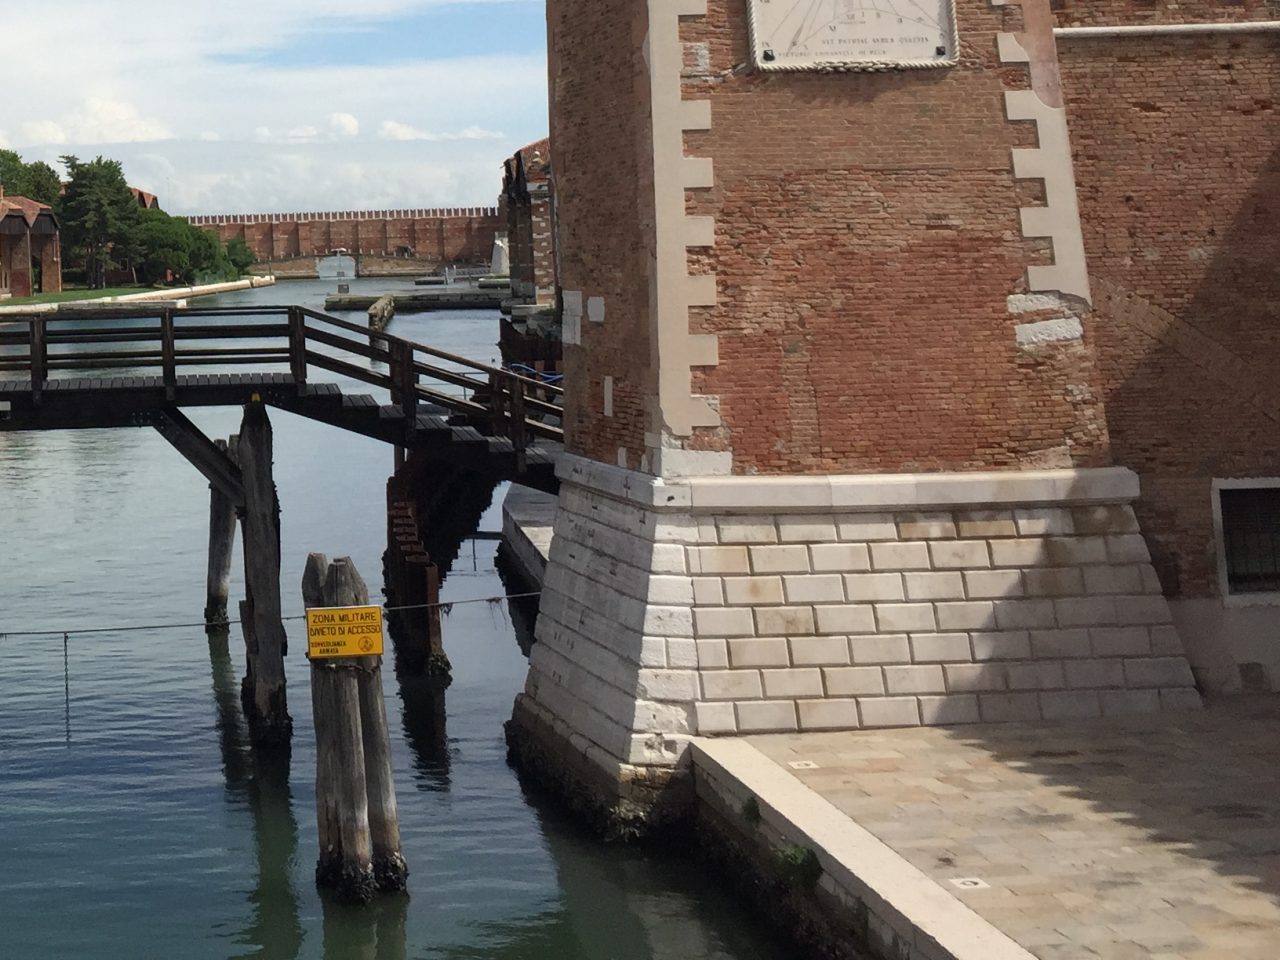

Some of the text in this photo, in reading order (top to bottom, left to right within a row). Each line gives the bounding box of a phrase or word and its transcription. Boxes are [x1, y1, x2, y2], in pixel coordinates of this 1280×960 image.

[312, 611, 377, 624] ZONA MILITARE
[310, 624, 381, 637] DIVIETO DI ACCESSO
